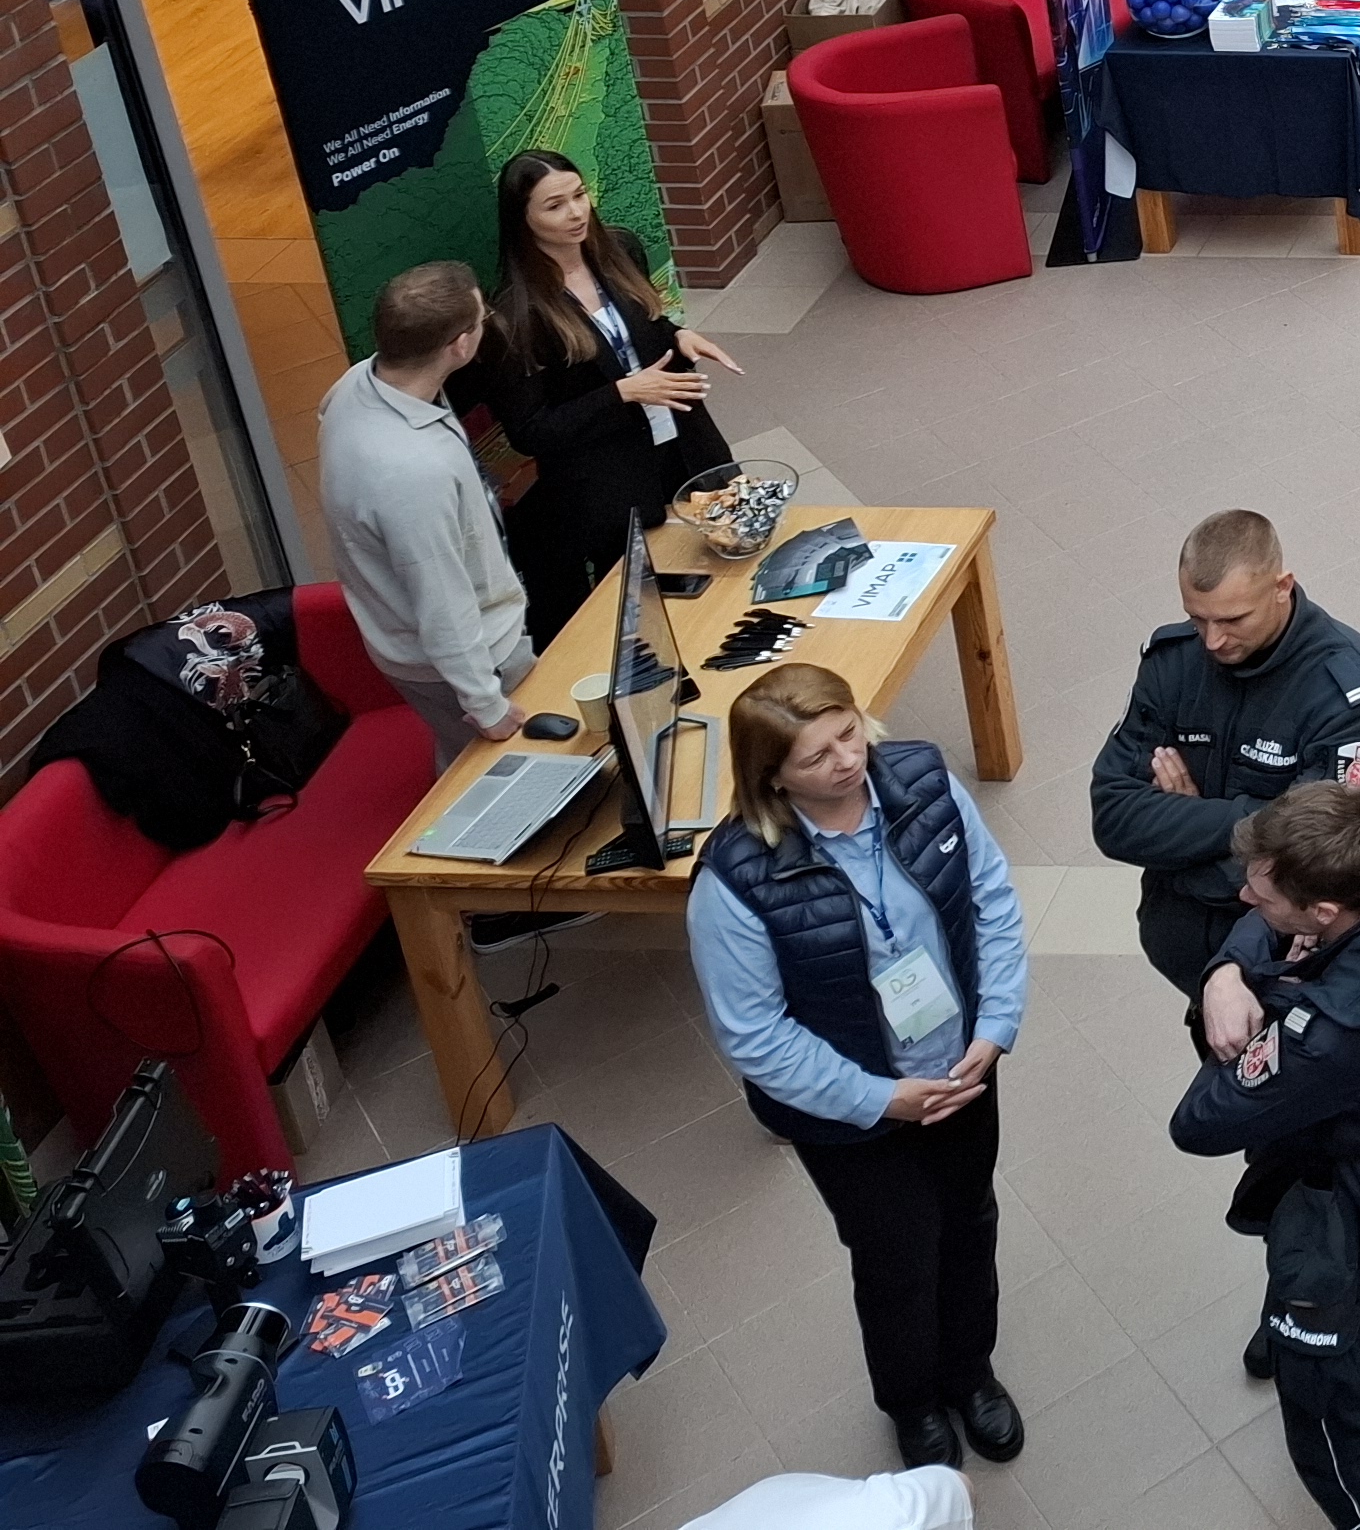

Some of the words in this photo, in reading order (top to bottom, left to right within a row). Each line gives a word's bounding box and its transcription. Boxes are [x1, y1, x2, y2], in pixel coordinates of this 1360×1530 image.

[323, 136, 344, 154] We
[345, 129, 358, 146] All
[360, 115, 389, 137] Need
[389, 85, 451, 121] Information
[327, 149, 347, 167] We
[348, 141, 362, 157] All
[363, 129, 392, 150] Need
[392, 111, 430, 136] Energy
[331, 155, 378, 187] Power
[379, 146, 400, 164] On
[852, 562, 897, 609] VIMAP
